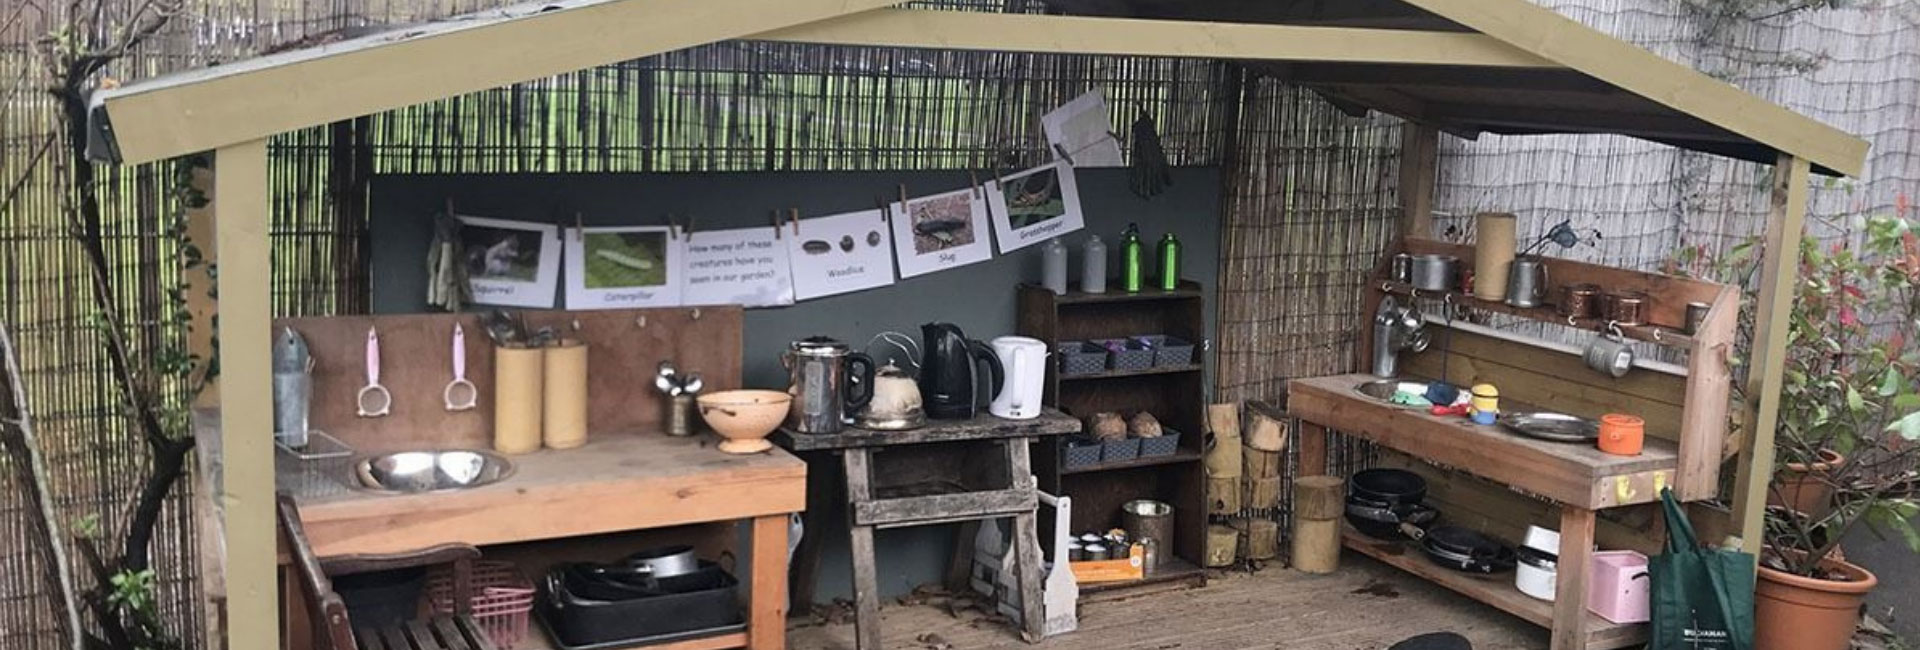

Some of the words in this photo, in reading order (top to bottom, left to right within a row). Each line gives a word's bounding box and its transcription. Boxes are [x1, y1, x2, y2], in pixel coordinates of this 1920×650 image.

[689, 245, 708, 253] How
[711, 244, 732, 254] many
[734, 241, 744, 251] of
[747, 240, 772, 249] these
[690, 259, 732, 269] creatures
[735, 257, 755, 266] have
[758, 257, 773, 265] you
[723, 274, 738, 283] our
